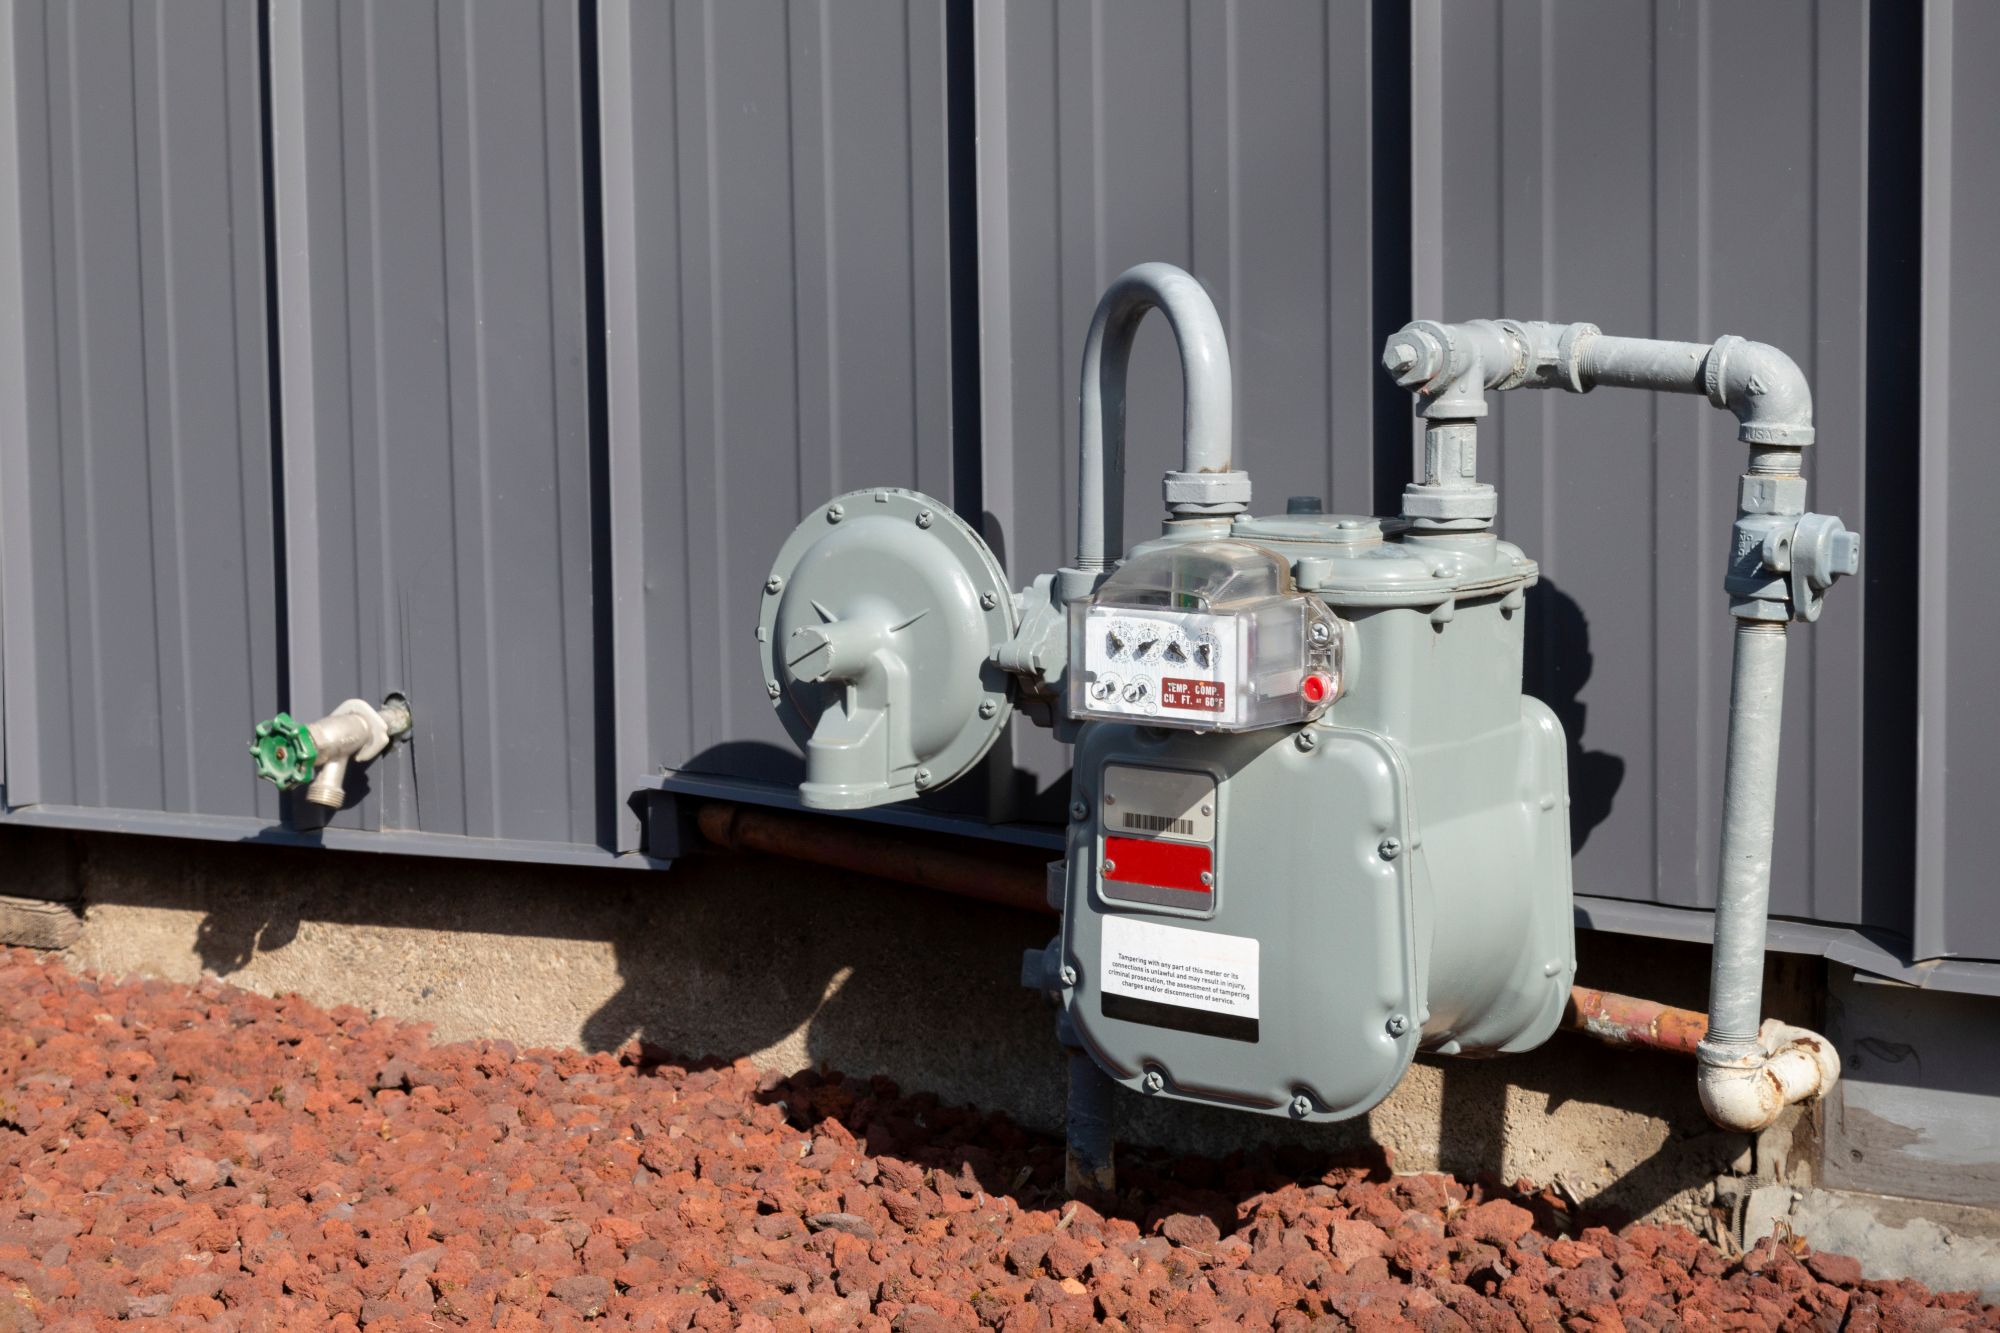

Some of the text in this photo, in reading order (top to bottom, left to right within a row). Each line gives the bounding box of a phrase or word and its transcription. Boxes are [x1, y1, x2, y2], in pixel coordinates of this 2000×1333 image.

[1163, 693, 1177, 704] CU.
[1181, 694, 1193, 705] FT.
[1168, 682, 1220, 697] TEMP. COMP.
[1112, 961, 1144, 973] connections
[1144, 966, 1150, 974] is
[1150, 968, 1175, 978] unlawful
[1188, 975, 1200, 983] may
[1201, 976, 1219, 985] result
[1226, 980, 1246, 990] injury,
[1118, 952, 1147, 965] Tampering
[1148, 959, 1160, 967] with
[1204, 969, 1222, 977] meter
[1231, 972, 1239, 980] its
[1108, 968, 1130, 979] criminal
[1131, 974, 1166, 986] prosecution,
[1166, 979, 1176, 987] the
[1176, 981, 1212, 992] assessment
[1219, 988, 1250, 1000] tampering
[1121, 979, 1144, 990] charges
[1144, 984, 1163, 993] and/or
[1163, 988, 1204, 1000] disconnection
[1211, 996, 1236, 1006] service.
